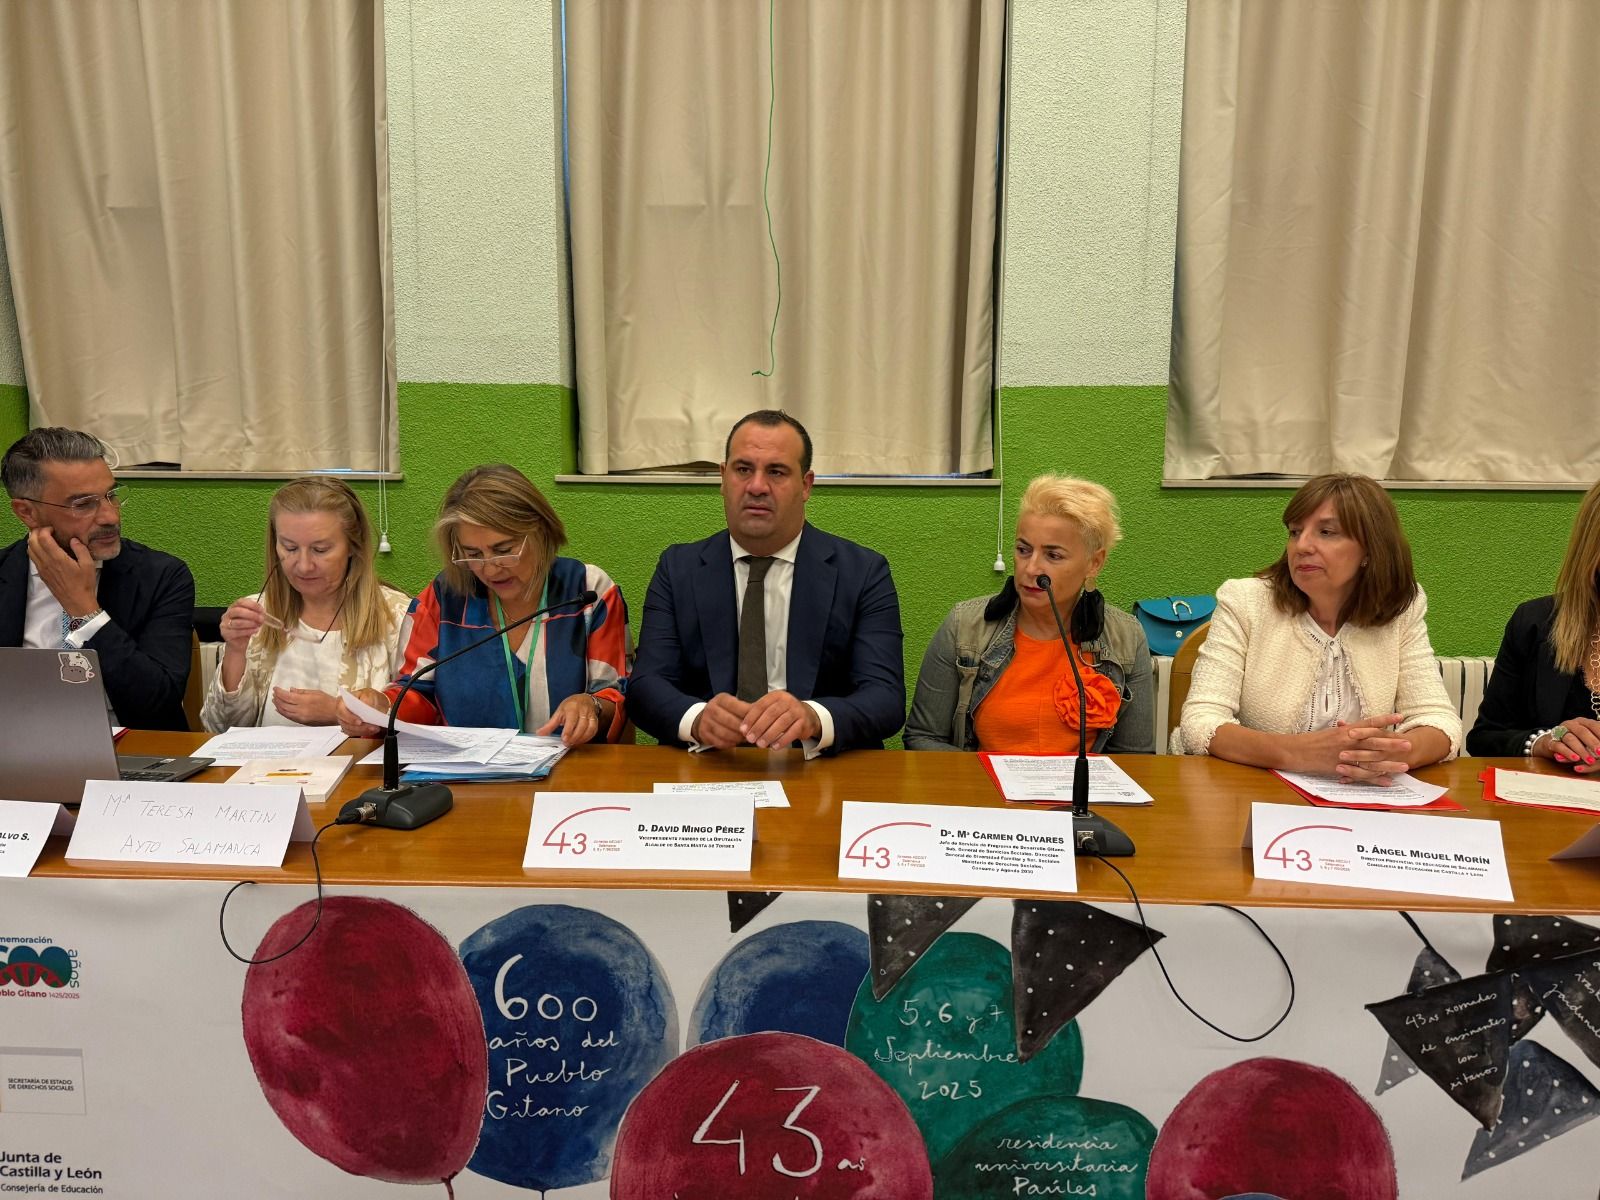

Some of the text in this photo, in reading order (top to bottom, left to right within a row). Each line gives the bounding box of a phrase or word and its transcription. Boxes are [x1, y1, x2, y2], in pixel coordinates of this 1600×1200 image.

[140, 800, 194, 819] TERESA
[215, 805, 277, 824] MARTIN
[20, 832, 30, 840] S.
[638, 824, 745, 834] D. DAVID MINGO PÉREZ
[972, 831, 1013, 841] CARMEN
[1016, 833, 1064, 844] OLIVARES
[119, 834, 262, 857] AYTO SALAMANCA
[1356, 844, 1490, 865] D. ÁNGEL MIGUEL MORÍN
[0, 989, 16, 997] blo
[18, 989, 47, 998] Gitano
[494, 953, 598, 1022] 600
[938, 1002, 953, 1023] 6
[965, 1014, 982, 1034] y
[989, 1004, 1005, 1022] 7
[489, 1030, 621, 1051] años del
[1421, 1043, 1438, 1054] de
[874, 1036, 1019, 1076] Septiembre
[1457, 1053, 1479, 1064] con
[8, 1076, 40, 1084] SECRETARÍA
[506, 1058, 611, 1087] Pueblo
[918, 1080, 982, 1100] 2025
[487, 1090, 590, 1120] Gitano
[997, 1133, 1117, 1149] residencia
[0, 1151, 62, 1163] Junta de
[975, 1152, 1138, 1173] universitaria
[0, 1165, 102, 1181] Castilla y León
[1, 1183, 103, 1194] Consejería de Educación
[1013, 1176, 1097, 1197] Paúles
